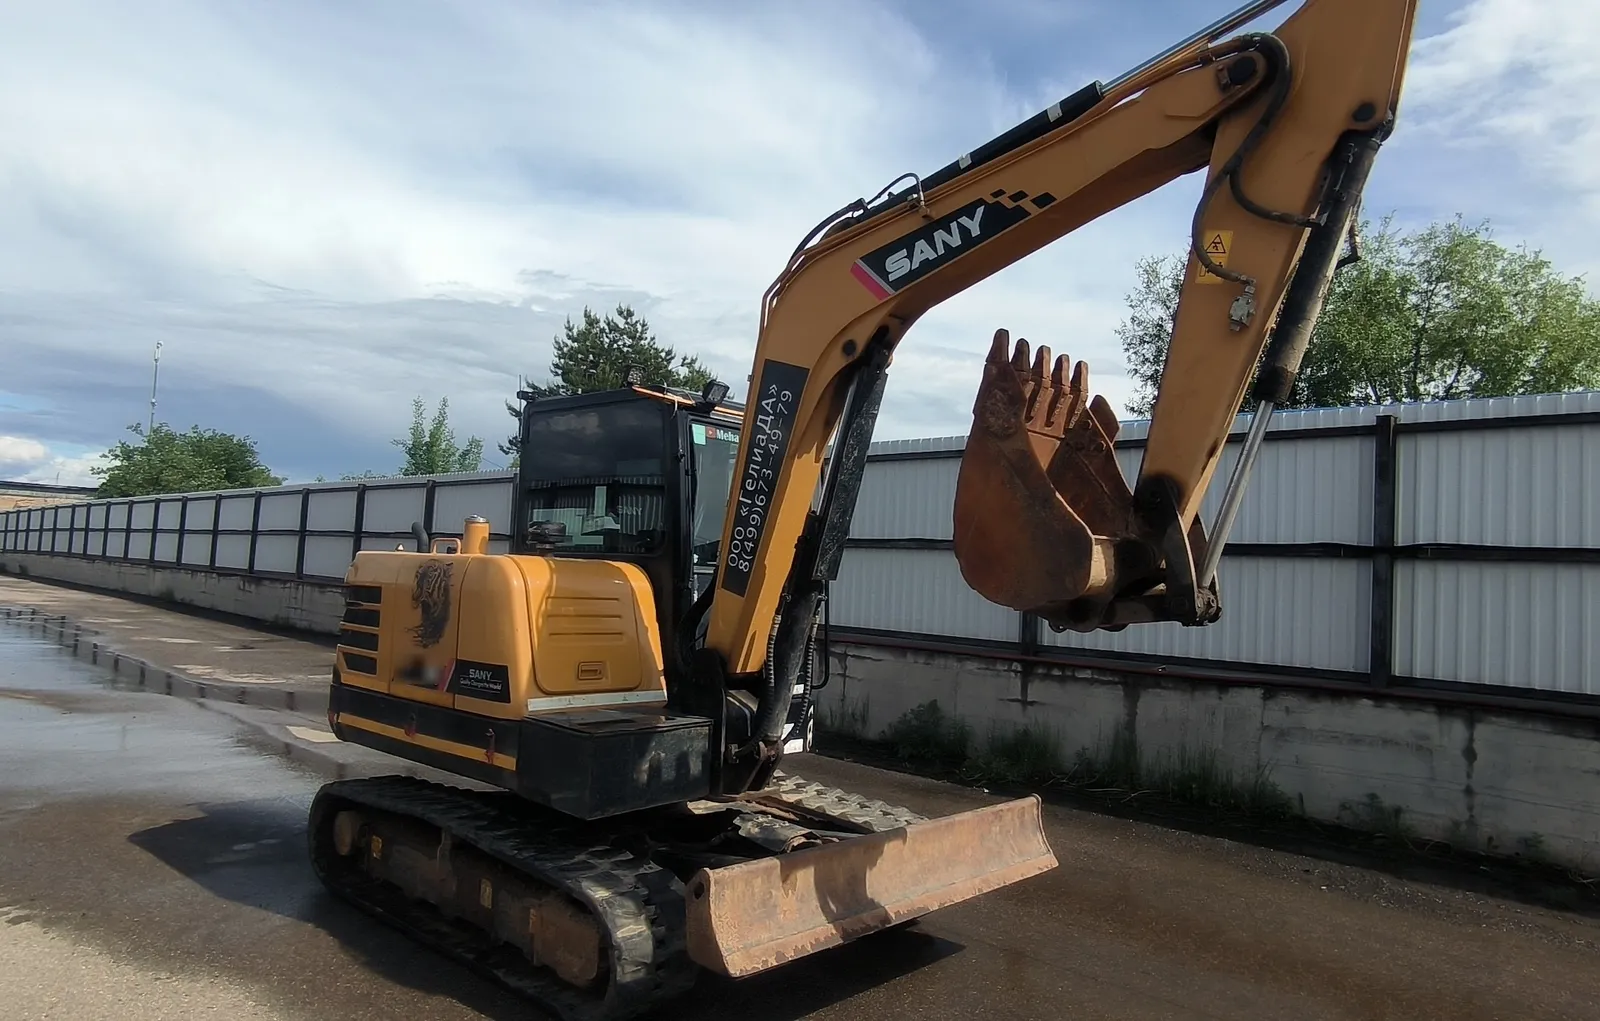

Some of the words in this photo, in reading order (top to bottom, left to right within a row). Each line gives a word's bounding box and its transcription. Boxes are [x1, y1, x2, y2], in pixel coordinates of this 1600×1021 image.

[884, 204, 986, 282] SANY
[738, 390, 792, 572] 8(499)673-49-79
[728, 526, 745, 567] ООО
[469, 668, 493, 681] SANY
